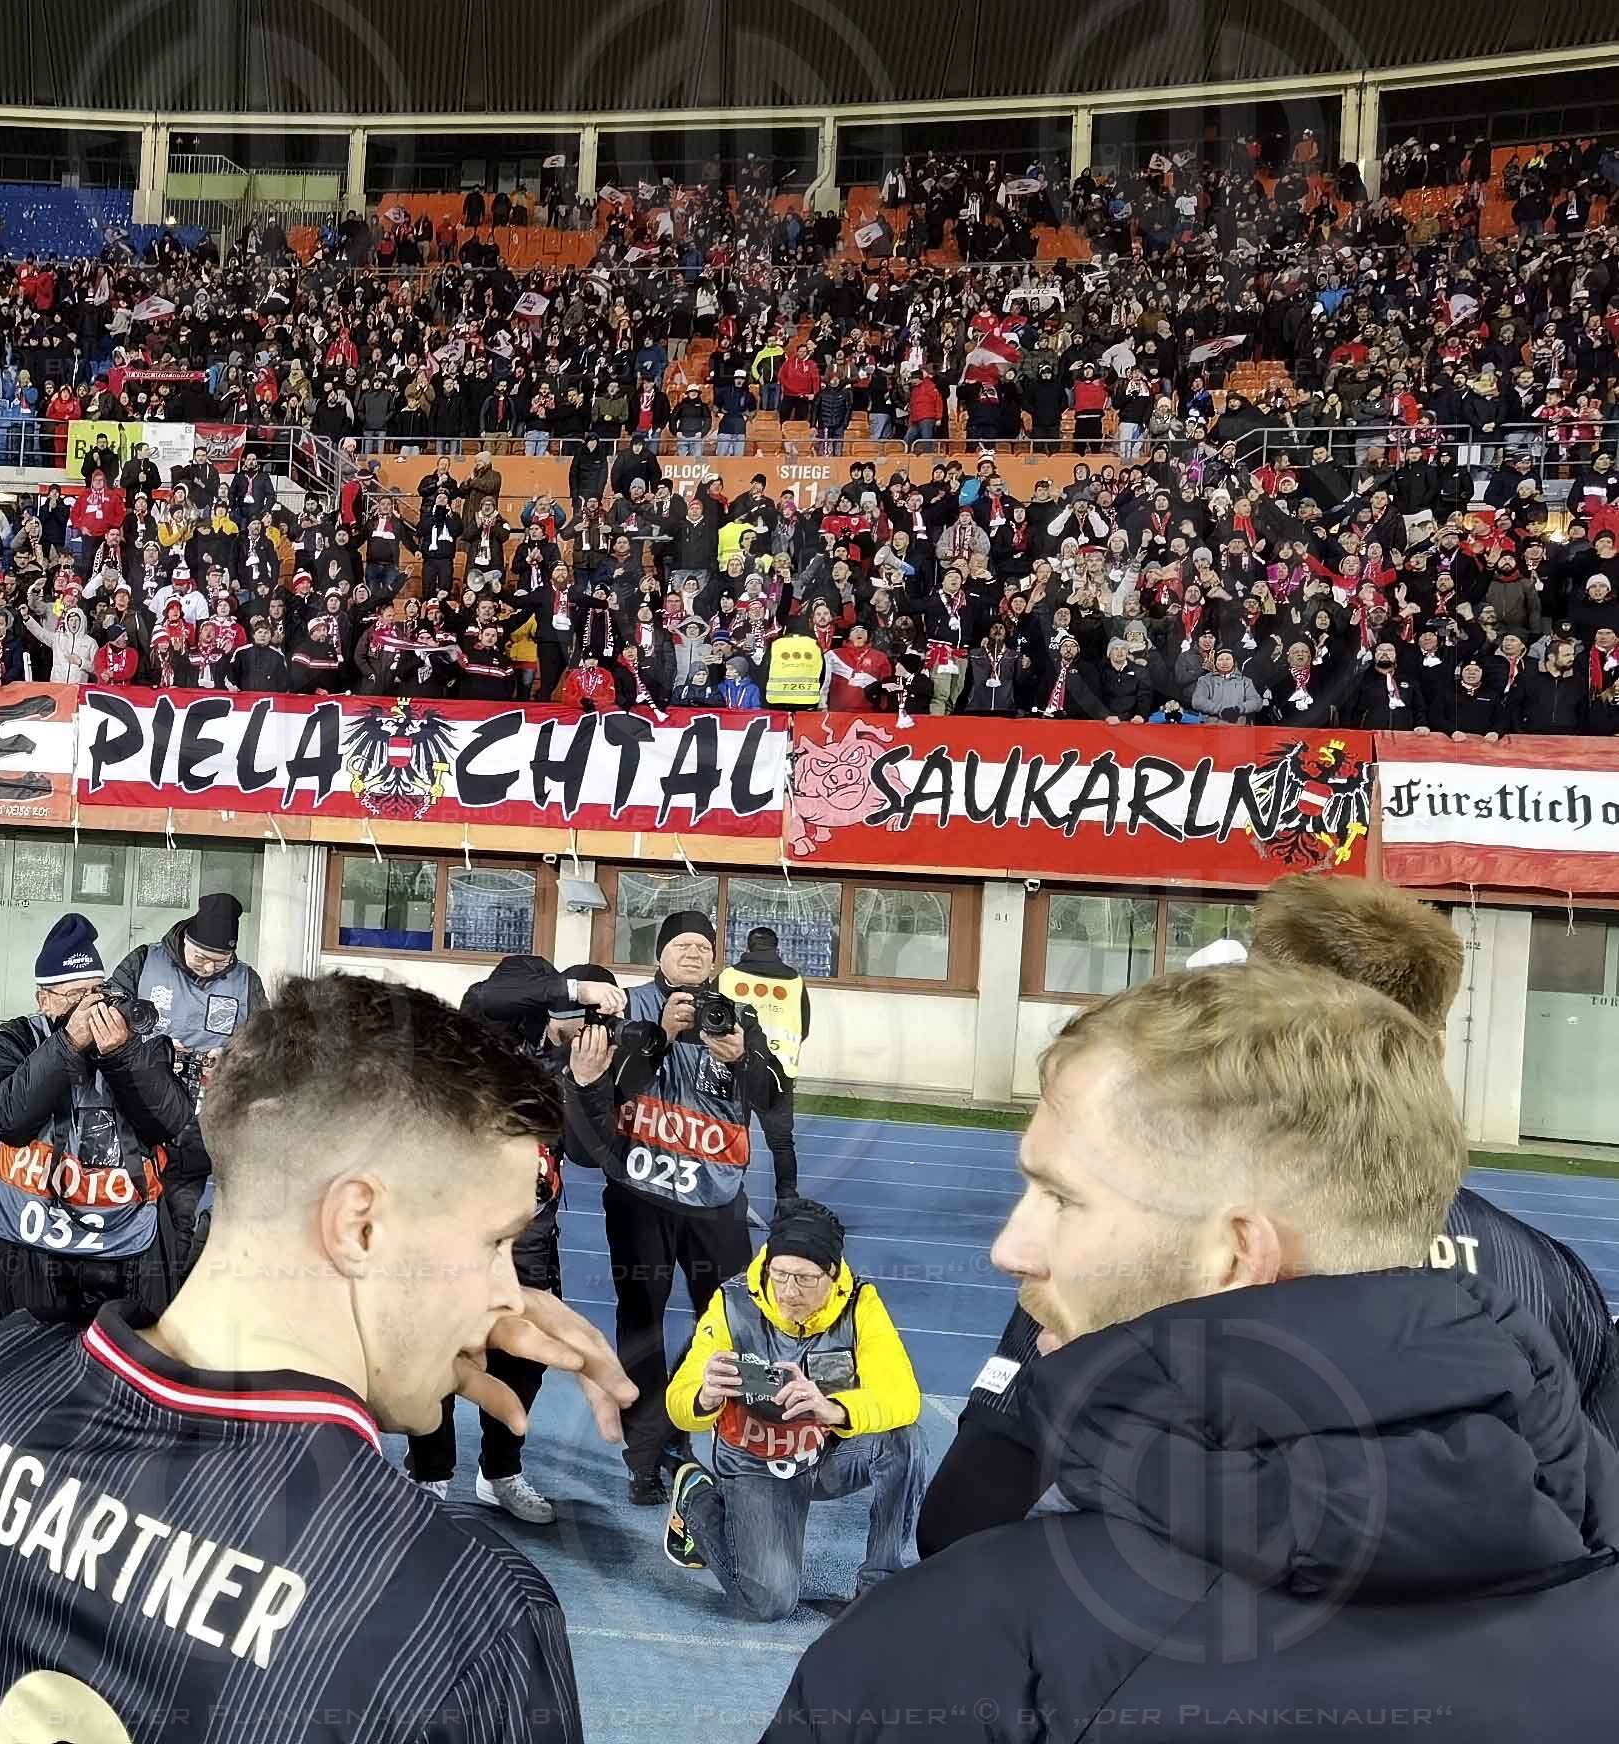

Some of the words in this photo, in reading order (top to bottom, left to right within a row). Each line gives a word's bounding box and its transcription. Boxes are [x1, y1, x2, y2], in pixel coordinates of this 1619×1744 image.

[663, 464, 710, 480] BLOCK
[780, 464, 831, 480] STIEGE
[85, 691, 345, 810] PIELA
[455, 709, 774, 827] CHTAL
[865, 740, 1284, 844] SAUKARLN
[1382, 778, 1592, 831] Fürstlich
[617, 1100, 725, 1154] PHOTO
[9, 1145, 135, 1204] PHOTO
[626, 1147, 702, 1193] 023
[19, 1201, 105, 1250] 032
